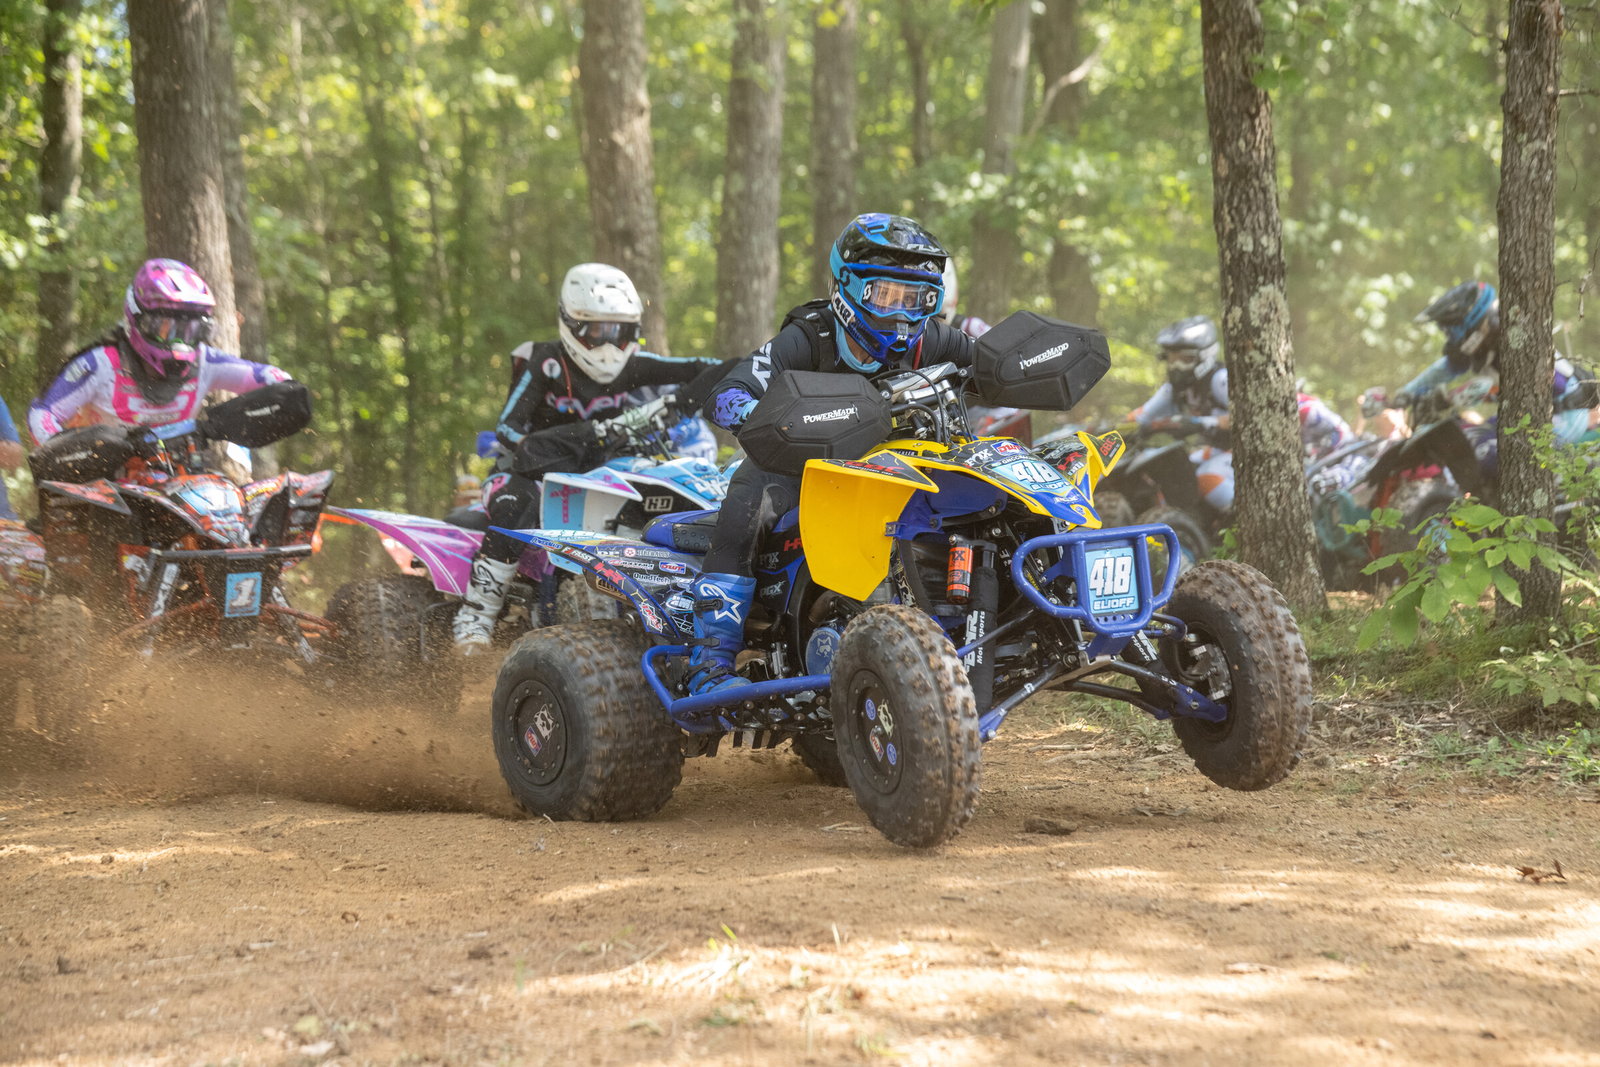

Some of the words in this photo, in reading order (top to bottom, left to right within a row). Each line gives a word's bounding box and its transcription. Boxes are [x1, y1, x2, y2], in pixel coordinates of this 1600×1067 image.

[964, 448, 994, 467] FOX
[1011, 461, 1062, 484] 418
[633, 572, 671, 585] QuadTech
[1089, 556, 1133, 597] 418
[1093, 597, 1135, 611] ELIOFF
